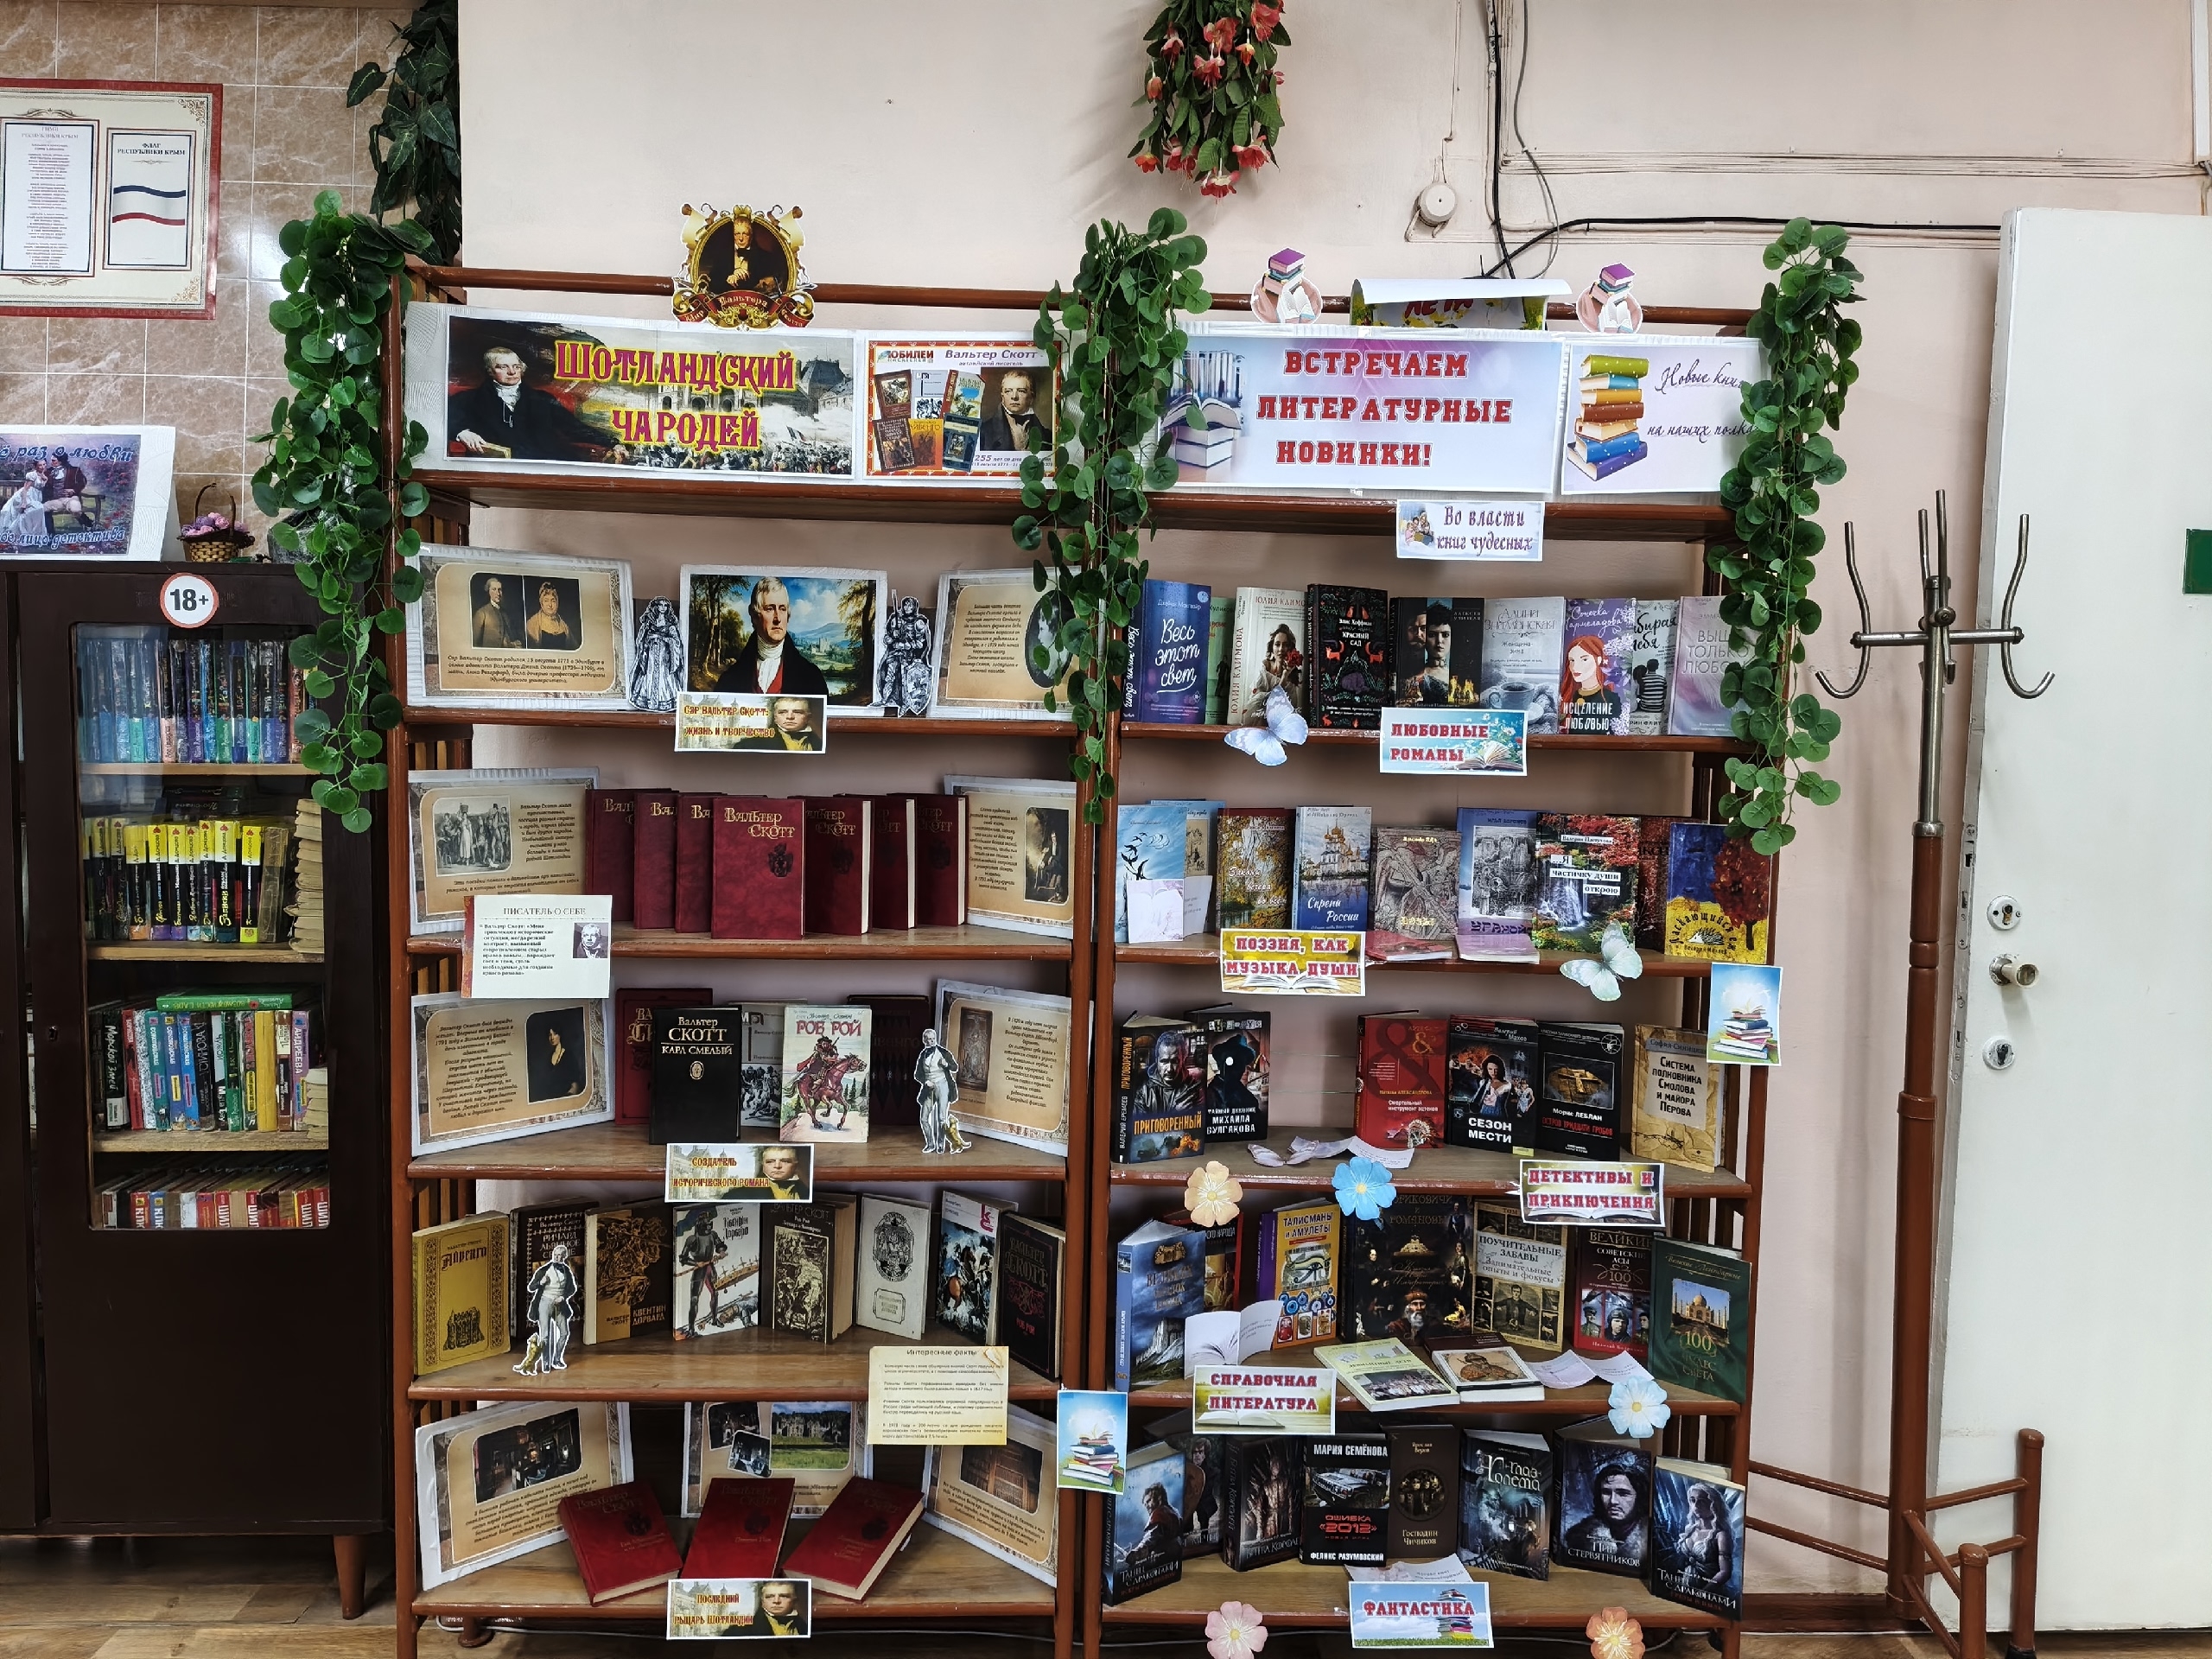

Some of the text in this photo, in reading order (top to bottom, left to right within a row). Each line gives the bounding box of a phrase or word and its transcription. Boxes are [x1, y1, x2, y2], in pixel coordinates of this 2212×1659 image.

[945, 350, 997, 359] Вальтер
[1001, 350, 1038, 359] Скотт
[555, 340, 795, 393] ШОТЛАНДСКИЙ
[1284, 349, 1469, 378] ВСТРЕЧАЕМ
[1655, 358, 1709, 394] Новые
[1255, 394, 1514, 423] ЛИТЕРАТУРНЫЕ
[611, 410, 760, 452] ЧАРОДЕЙ
[1648, 423, 1711, 443] на наших
[12, 444, 47, 461] раз
[69, 443, 133, 462] любви
[1275, 439, 1433, 467] НОВИНКИ!
[1444, 505, 1525, 527] Во власти
[19, 529, 126, 550] лицо детектива
[1436, 532, 1533, 556] книг чудесных
[169, 589, 209, 612] 18+
[1571, 601, 1610, 620] Сонечка
[1161, 619, 1196, 644] Весь
[1342, 631, 1370, 641] КРАСНЫЙ
[1350, 639, 1362, 648] САД
[1155, 643, 1200, 666] этот
[1160, 662, 1198, 687] свет
[1230, 627, 1244, 714] ЮЛИЯ КЛИМОВА
[684, 705, 769, 717] СЭР ВАЛЬТЕР СКОТТ:
[1563, 700, 1613, 715] ИСЦЕЛЕНИЕ
[1390, 722, 1490, 739] ЛЮБОВНЫЕ
[1563, 717, 1610, 731] ЛЮБОВЬЮ
[684, 727, 714, 736] ЖИЗНЬ
[722, 728, 776, 738] ТВОРЧЕСТВО
[1389, 747, 1465, 762] РОМАНЫ
[1552, 869, 1619, 881] частичку души
[504, 907, 553, 916] ПИСАТЕЛЬ
[1326, 910, 1358, 923] России
[1236, 937, 1349, 953] ПОЭЗИЯ, КАК
[1225, 961, 1358, 976] МУЗЫКА ДУШИ
[677, 1016, 718, 1027] Вальтер
[797, 1018, 861, 1037] РОБ РОЙ
[669, 1028, 728, 1041] СКОТТ
[105, 1025, 118, 1063] Морской
[294, 1027, 302, 1074] АНДРЕЕВА
[662, 1046, 733, 1055] КАРЛ СМЕЛЫЙ
[1122, 1037, 1133, 1090] ПРИГОВОРЕННЫЙ
[1134, 1111, 1202, 1135] ПРИГОВОРЕННЫЙ
[1212, 1115, 1249, 1124] МИХАИЛА
[1469, 1118, 1512, 1130] СЕЗОН
[1575, 1111, 1603, 1122] ЛЕБЛАН
[1206, 1123, 1255, 1135] БУЛГАКОВА
[1469, 1129, 1512, 1144] МЕСТИ
[691, 1156, 737, 1168] СОЗДАТЕЛЬ
[672, 1177, 770, 1187] ИСТОРИЧЕСКОГО РОМАНА
[1527, 1170, 1654, 1185] ДЕТЕКТИВЫ И
[1526, 1192, 1656, 1210] ПРИКЛЮЧЕНИЯ
[1283, 1211, 1334, 1227] ТАЛИСМАНЫ
[543, 1232, 577, 1243] РИЧАРД
[1292, 1224, 1331, 1237] АМУЛЕТЫ
[1479, 1236, 1562, 1256] ПОУЧИТЕЛЬНЫЕ
[1597, 1247, 1646, 1258] СОВЕТСКИЕ
[1500, 1249, 1540, 1263] ЗАБАВЫ
[1612, 1256, 1630, 1265] АСЫ
[1485, 1255, 1552, 1276] Занимательные
[1483, 1265, 1510, 1277] опыты
[1520, 1270, 1554, 1284] фокусы
[1609, 1271, 1631, 1284] 100
[632, 1305, 666, 1317] КВЕНТИН
[632, 1313, 665, 1325] ДОРВАРД
[1686, 1331, 1712, 1351] 100
[1210, 1374, 1319, 1388] СПРАВОЧНАЯ
[1209, 1396, 1318, 1410] ЛИТЕРАТУРА
[1313, 1443, 1388, 1457] МАРИЯ СЕМЁНОВА
[1325, 1514, 1372, 1522] ОШИБКА
[1319, 1522, 1377, 1534] «2012»
[1402, 1529, 1438, 1538] Господин
[1402, 1536, 1437, 1547] Чичиков
[1310, 1552, 1384, 1562] ФЕЛИКС РАЗУМОВСКИЙ
[1567, 1548, 1640, 1567] СТЕРВЯТНИКОВ
[696, 1593, 740, 1605] ПОСЛЕДНИЙ
[1674, 1583, 1736, 1609] ДРАКОНАМИ
[1363, 1600, 1476, 1618] ФАНТАСТИКА
[674, 1615, 753, 1625] РЫЦАРЬ ШОТЛАНДИИ
